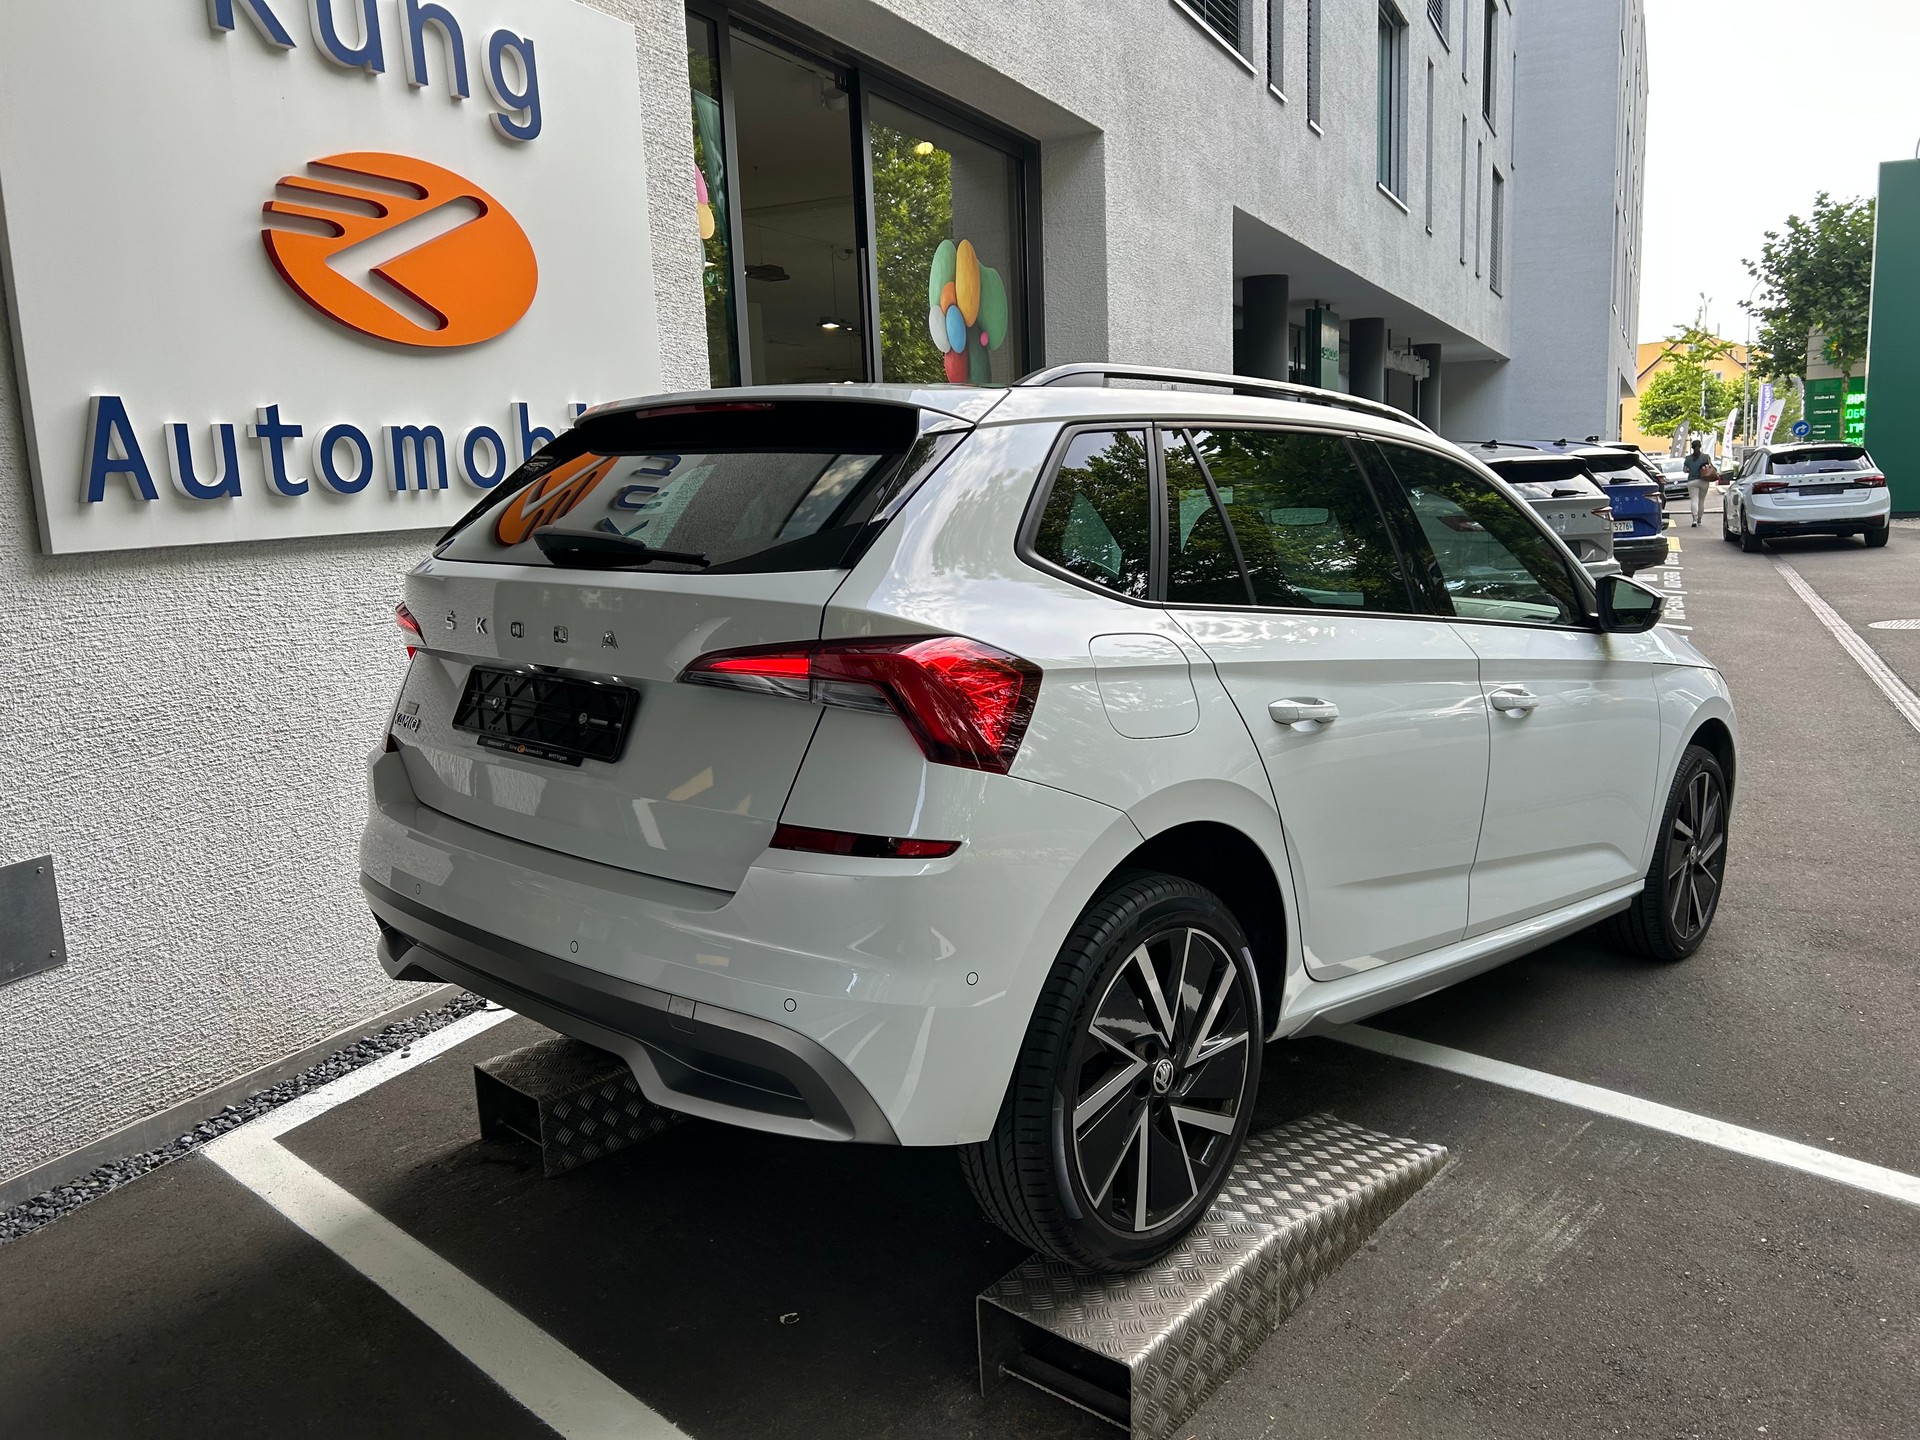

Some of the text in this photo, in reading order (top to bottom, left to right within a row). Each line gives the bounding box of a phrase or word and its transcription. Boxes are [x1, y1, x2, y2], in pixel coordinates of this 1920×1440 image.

[81, 393, 587, 502] Automob
[1546, 512, 1587, 520] KODA
[1613, 521, 1630, 532] 5276
[445, 609, 619, 650] ŠKODA
